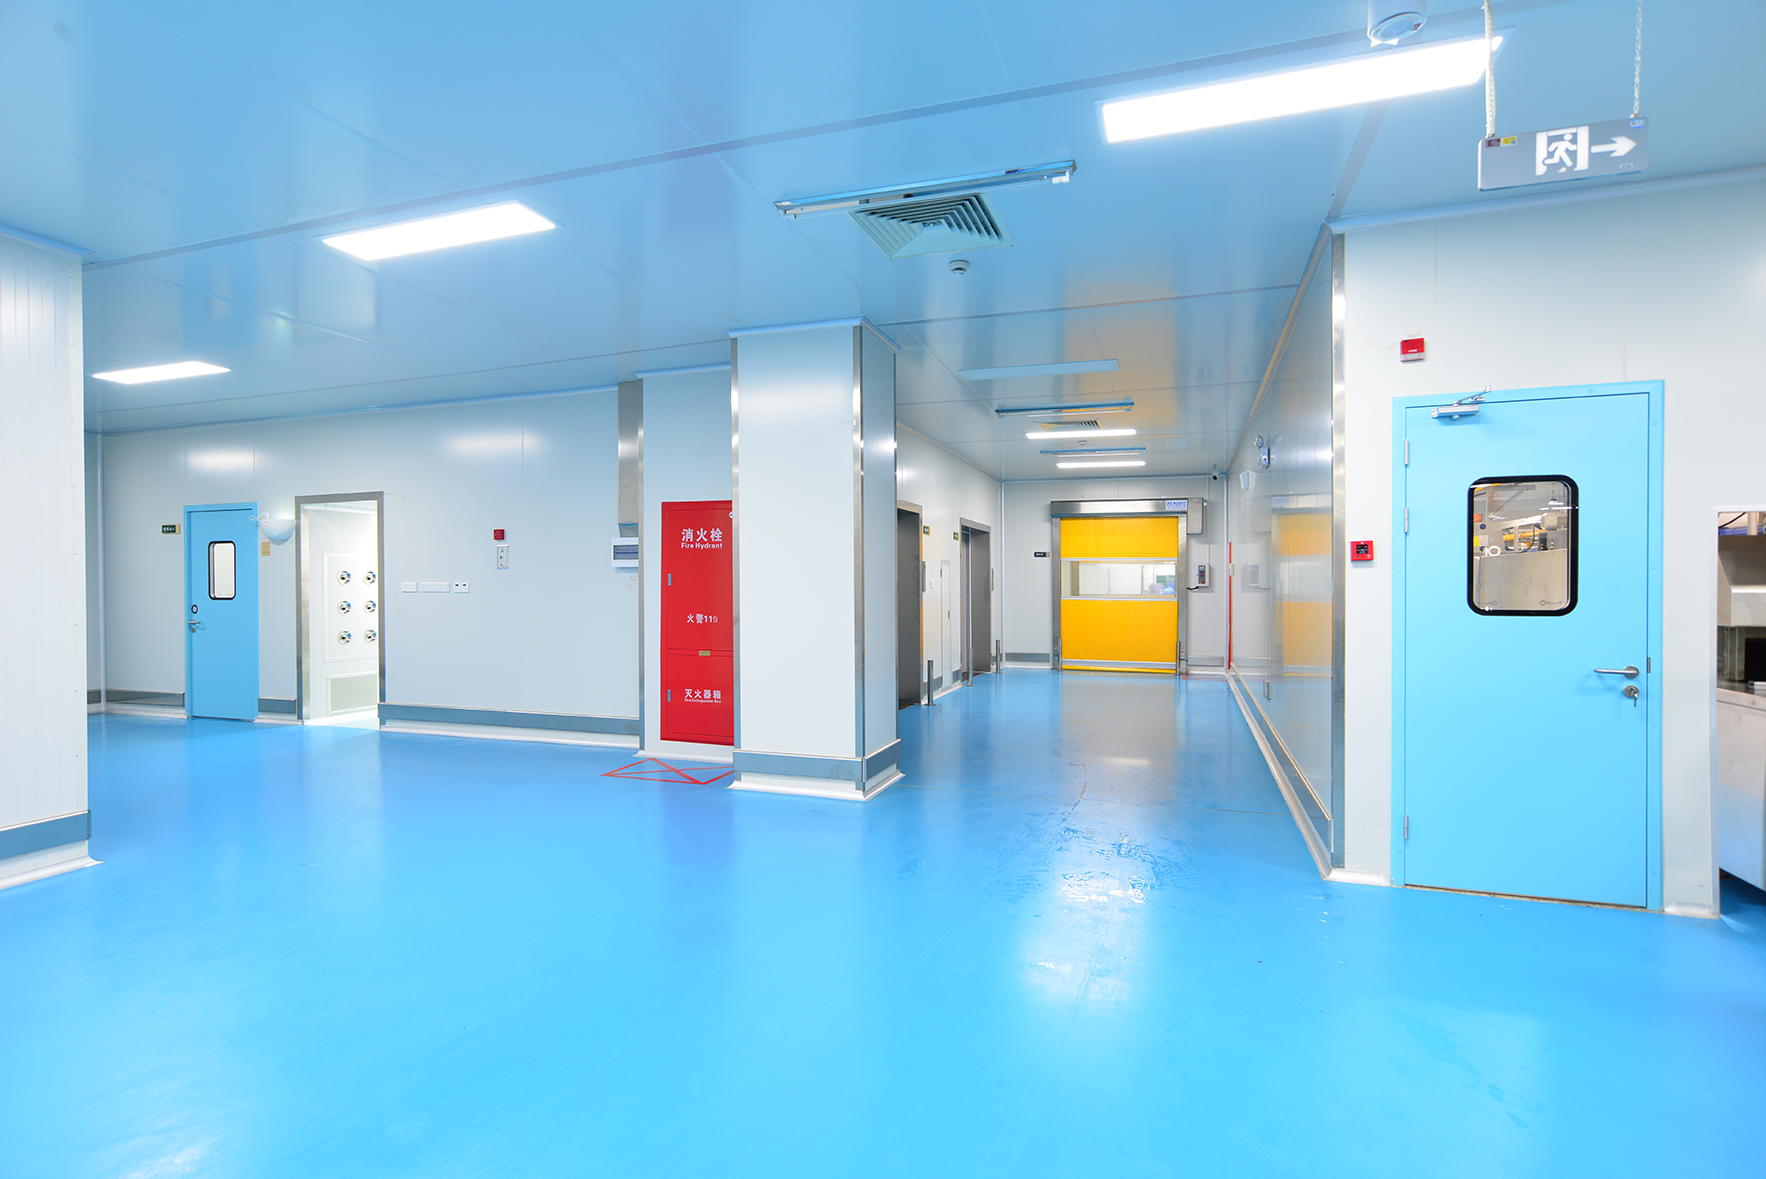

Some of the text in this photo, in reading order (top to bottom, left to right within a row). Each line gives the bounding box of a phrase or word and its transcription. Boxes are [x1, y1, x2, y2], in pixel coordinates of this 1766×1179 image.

[681, 528, 723, 542] 消火栓
[695, 542, 723, 550] Hydrant
[684, 688, 721, 699] 灭火器箱
